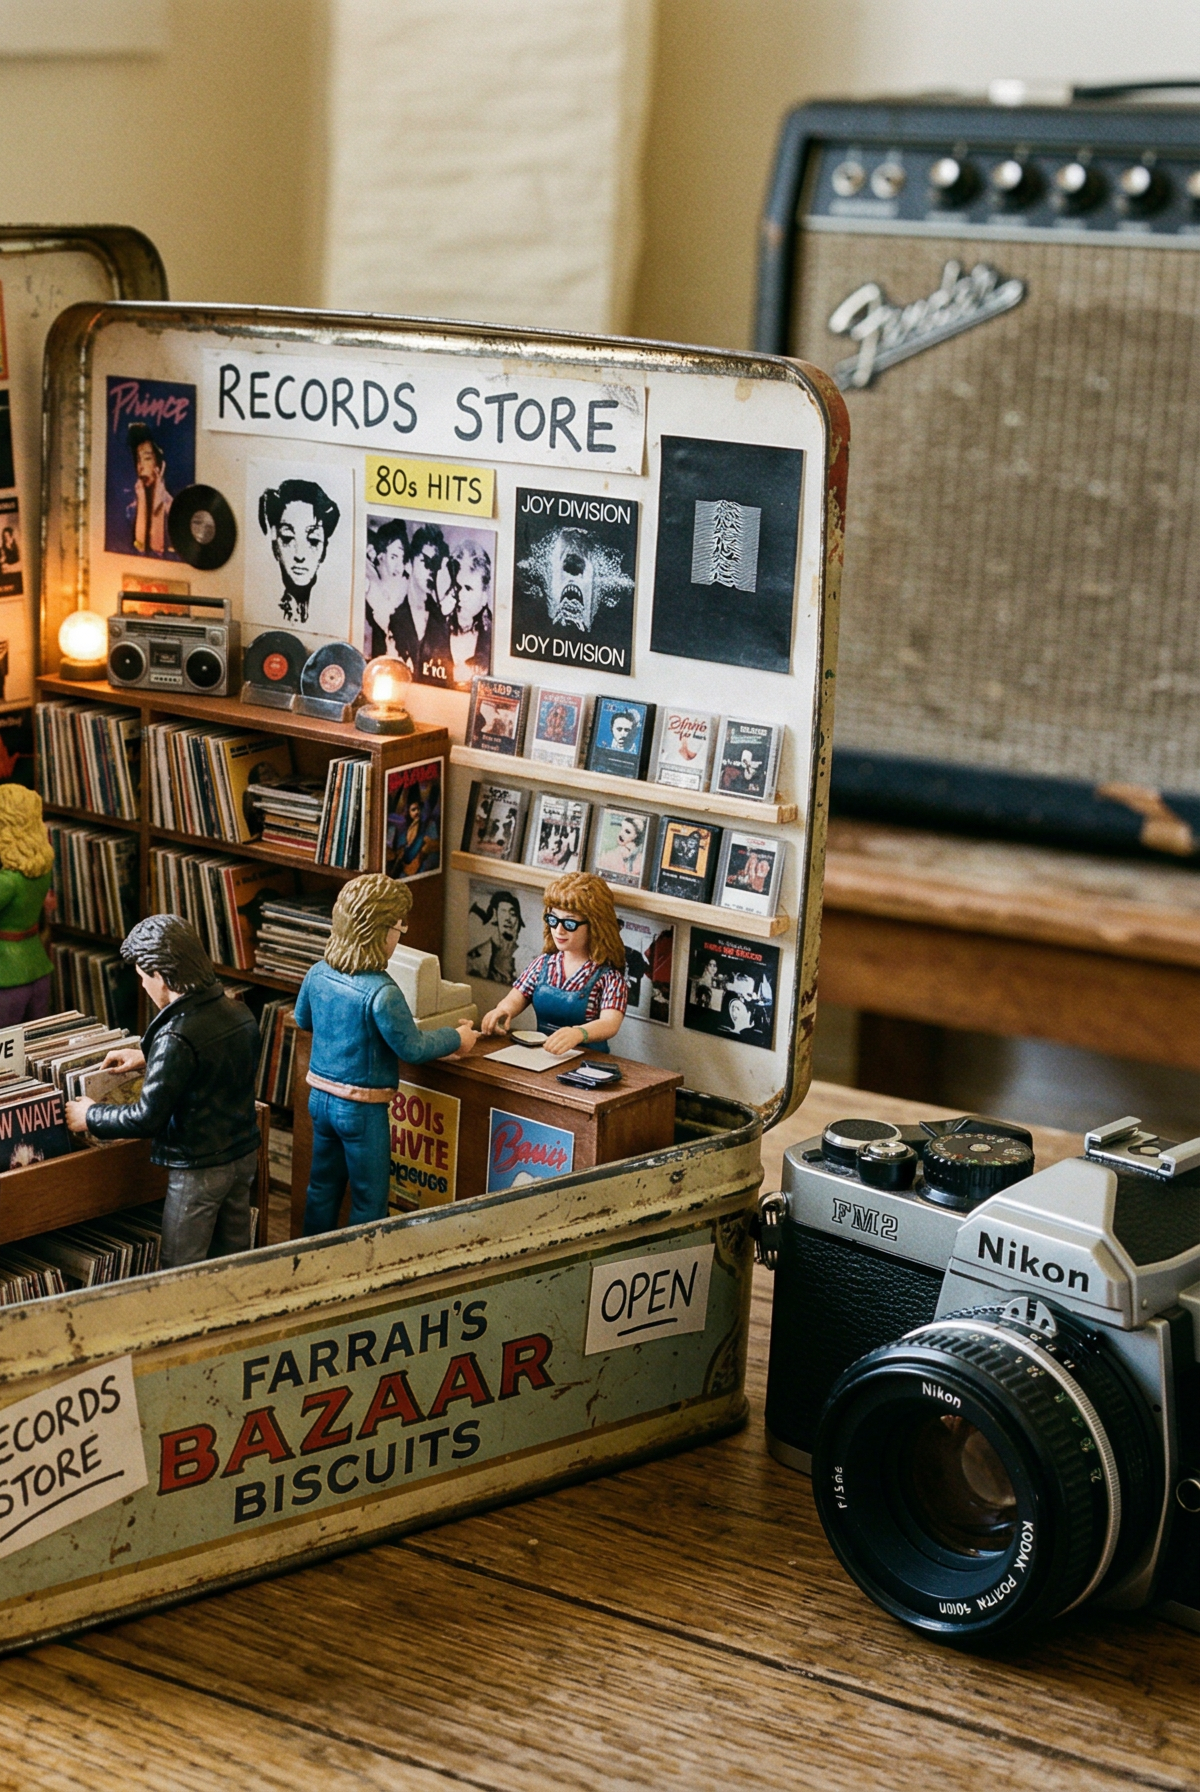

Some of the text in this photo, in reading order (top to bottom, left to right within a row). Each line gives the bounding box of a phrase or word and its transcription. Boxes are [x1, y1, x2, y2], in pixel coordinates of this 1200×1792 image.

[109, 381, 190, 433] Prince
[218, 363, 620, 454] RECORDS STORE
[376, 465, 482, 504] 80s HITS
[521, 495, 631, 524] JOY DIVISION
[516, 634, 625, 668] JOY DIVISION
[16, 1098, 64, 1135] WAVE
[831, 1197, 899, 1242] FM2
[977, 1230, 1090, 1293] Nikon
[601, 1260, 699, 1323] OPEN
[242, 1299, 488, 1400] FARRAH'S
[157, 1332, 556, 1496] BAZAAR
[922, 1381, 962, 1409] Nikon
[234, 1419, 481, 1525] BISCUITS
[1013, 1520, 1034, 1573] KODAK
